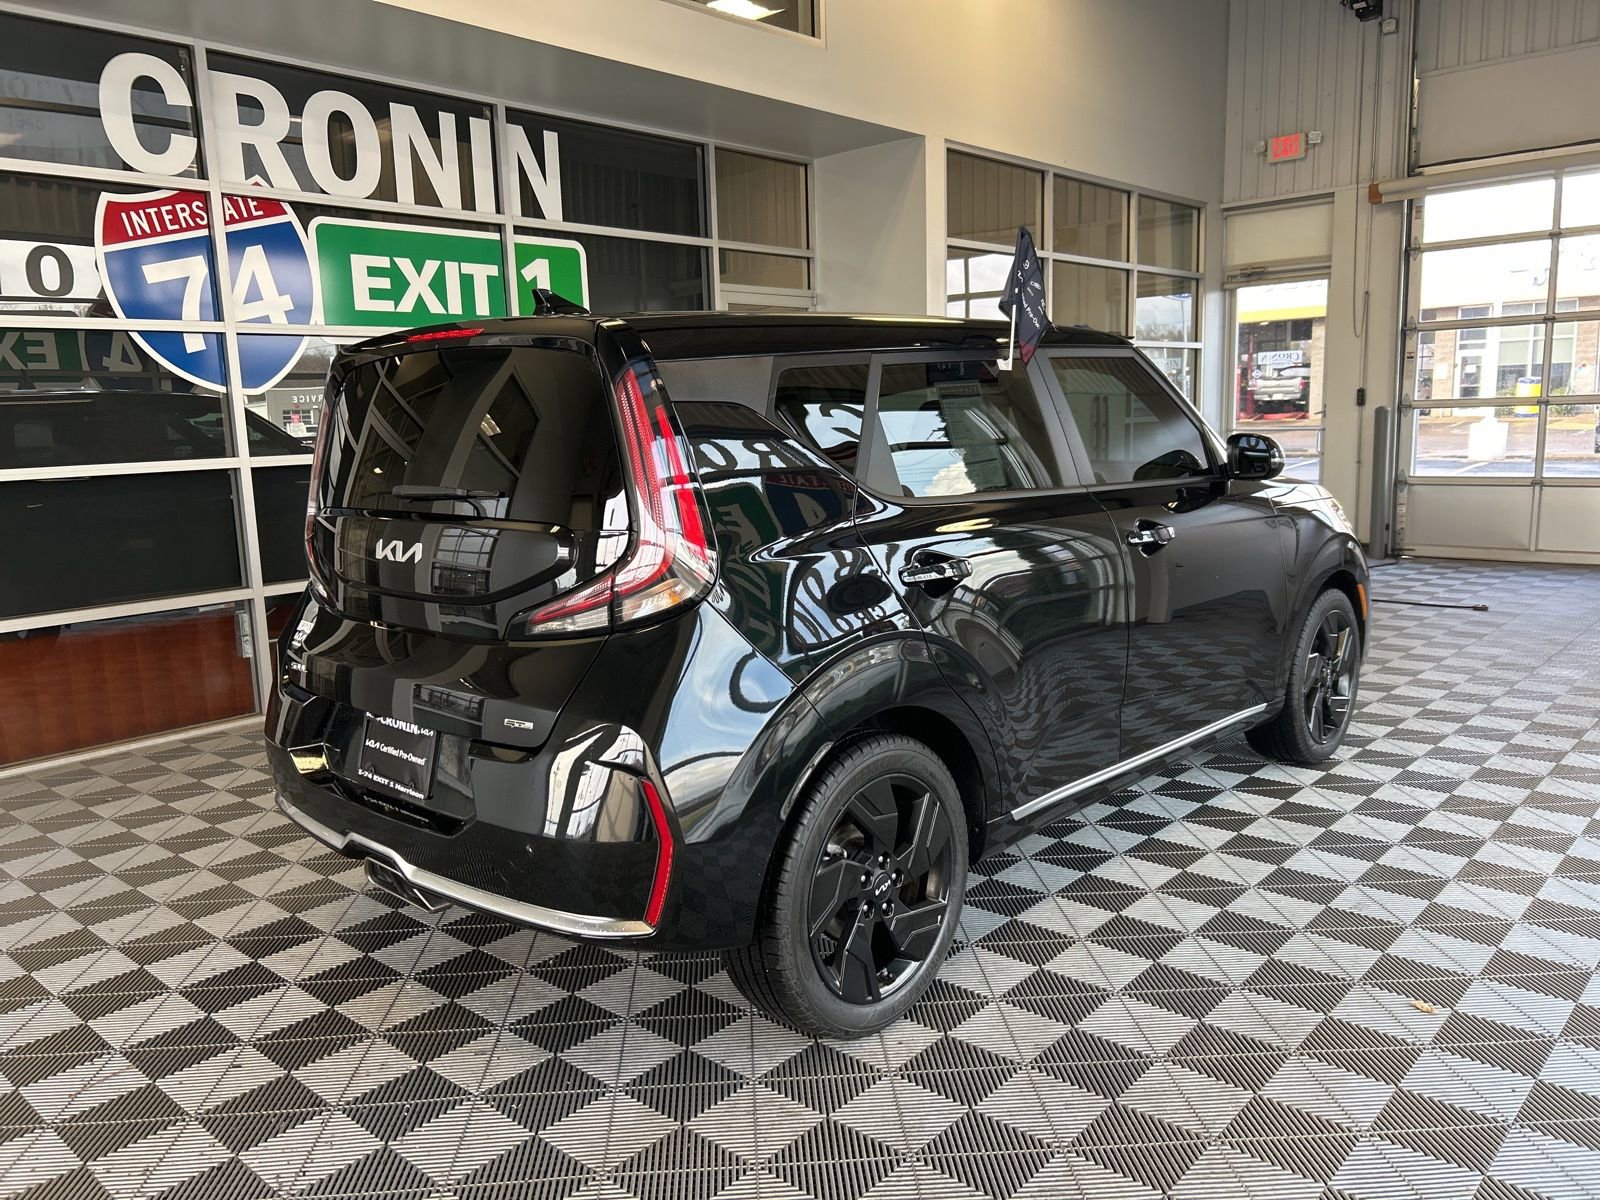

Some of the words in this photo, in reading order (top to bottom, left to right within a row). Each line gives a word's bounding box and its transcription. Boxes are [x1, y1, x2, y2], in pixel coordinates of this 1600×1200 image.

[99, 52, 563, 222] CRONIN
[1272, 133, 1300, 159] EXIT
[120, 196, 264, 238] INTERSATE
[350, 253, 499, 316] EXIT
[520, 258, 551, 290] 1
[142, 244, 294, 354] 74
[375, 537, 423, 564] KIA
[365, 738, 380, 749] KIA
[380, 743, 400, 757] Certified
[400, 749, 426, 766] Pre-Owned
[373, 774, 389, 786] EXIT
[394, 783, 425, 800] Harrison
[874, 878, 892, 896] KIA
